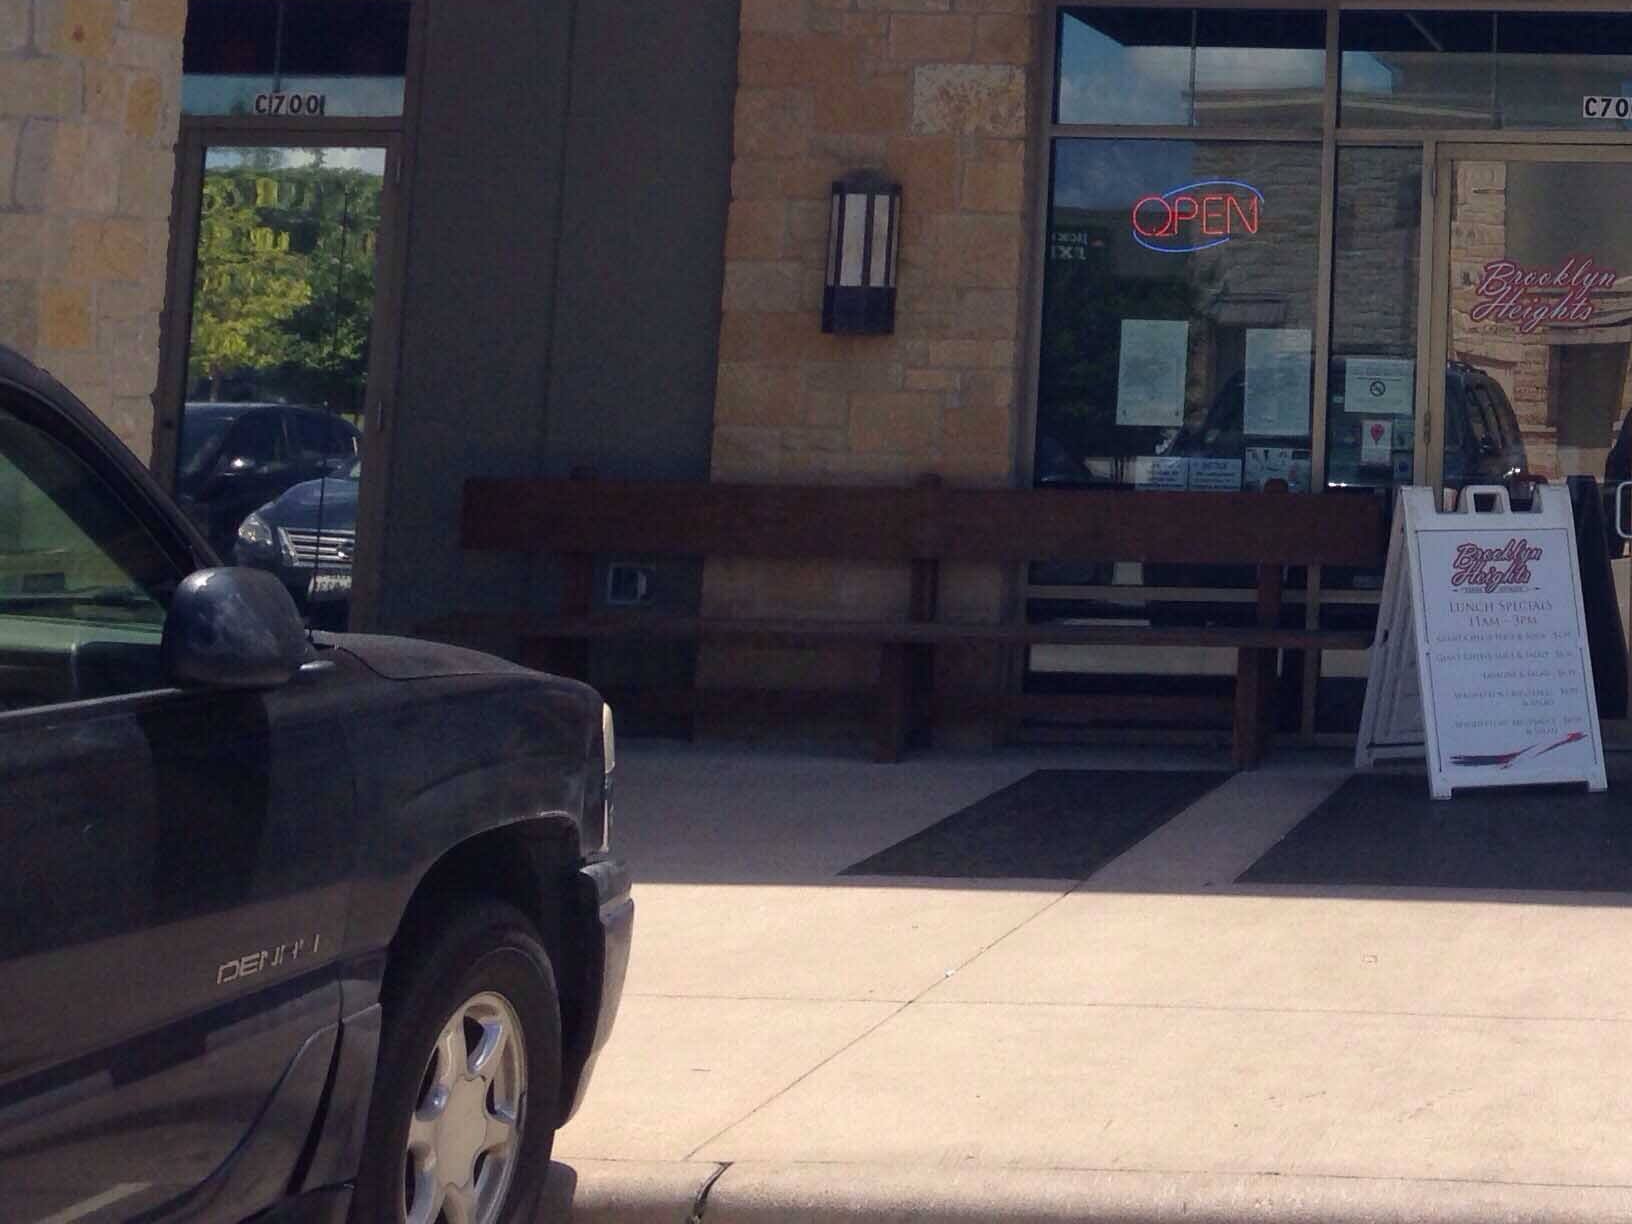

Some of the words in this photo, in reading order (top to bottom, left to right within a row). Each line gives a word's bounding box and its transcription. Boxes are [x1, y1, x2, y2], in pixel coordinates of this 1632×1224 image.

[255, 94, 319, 114] C700
[1131, 194, 1259, 237] OPEN
[1477, 257, 1617, 300] Brooklyn
[1471, 286, 1594, 334] Heights
[1453, 538, 1543, 569] Brooklyn
